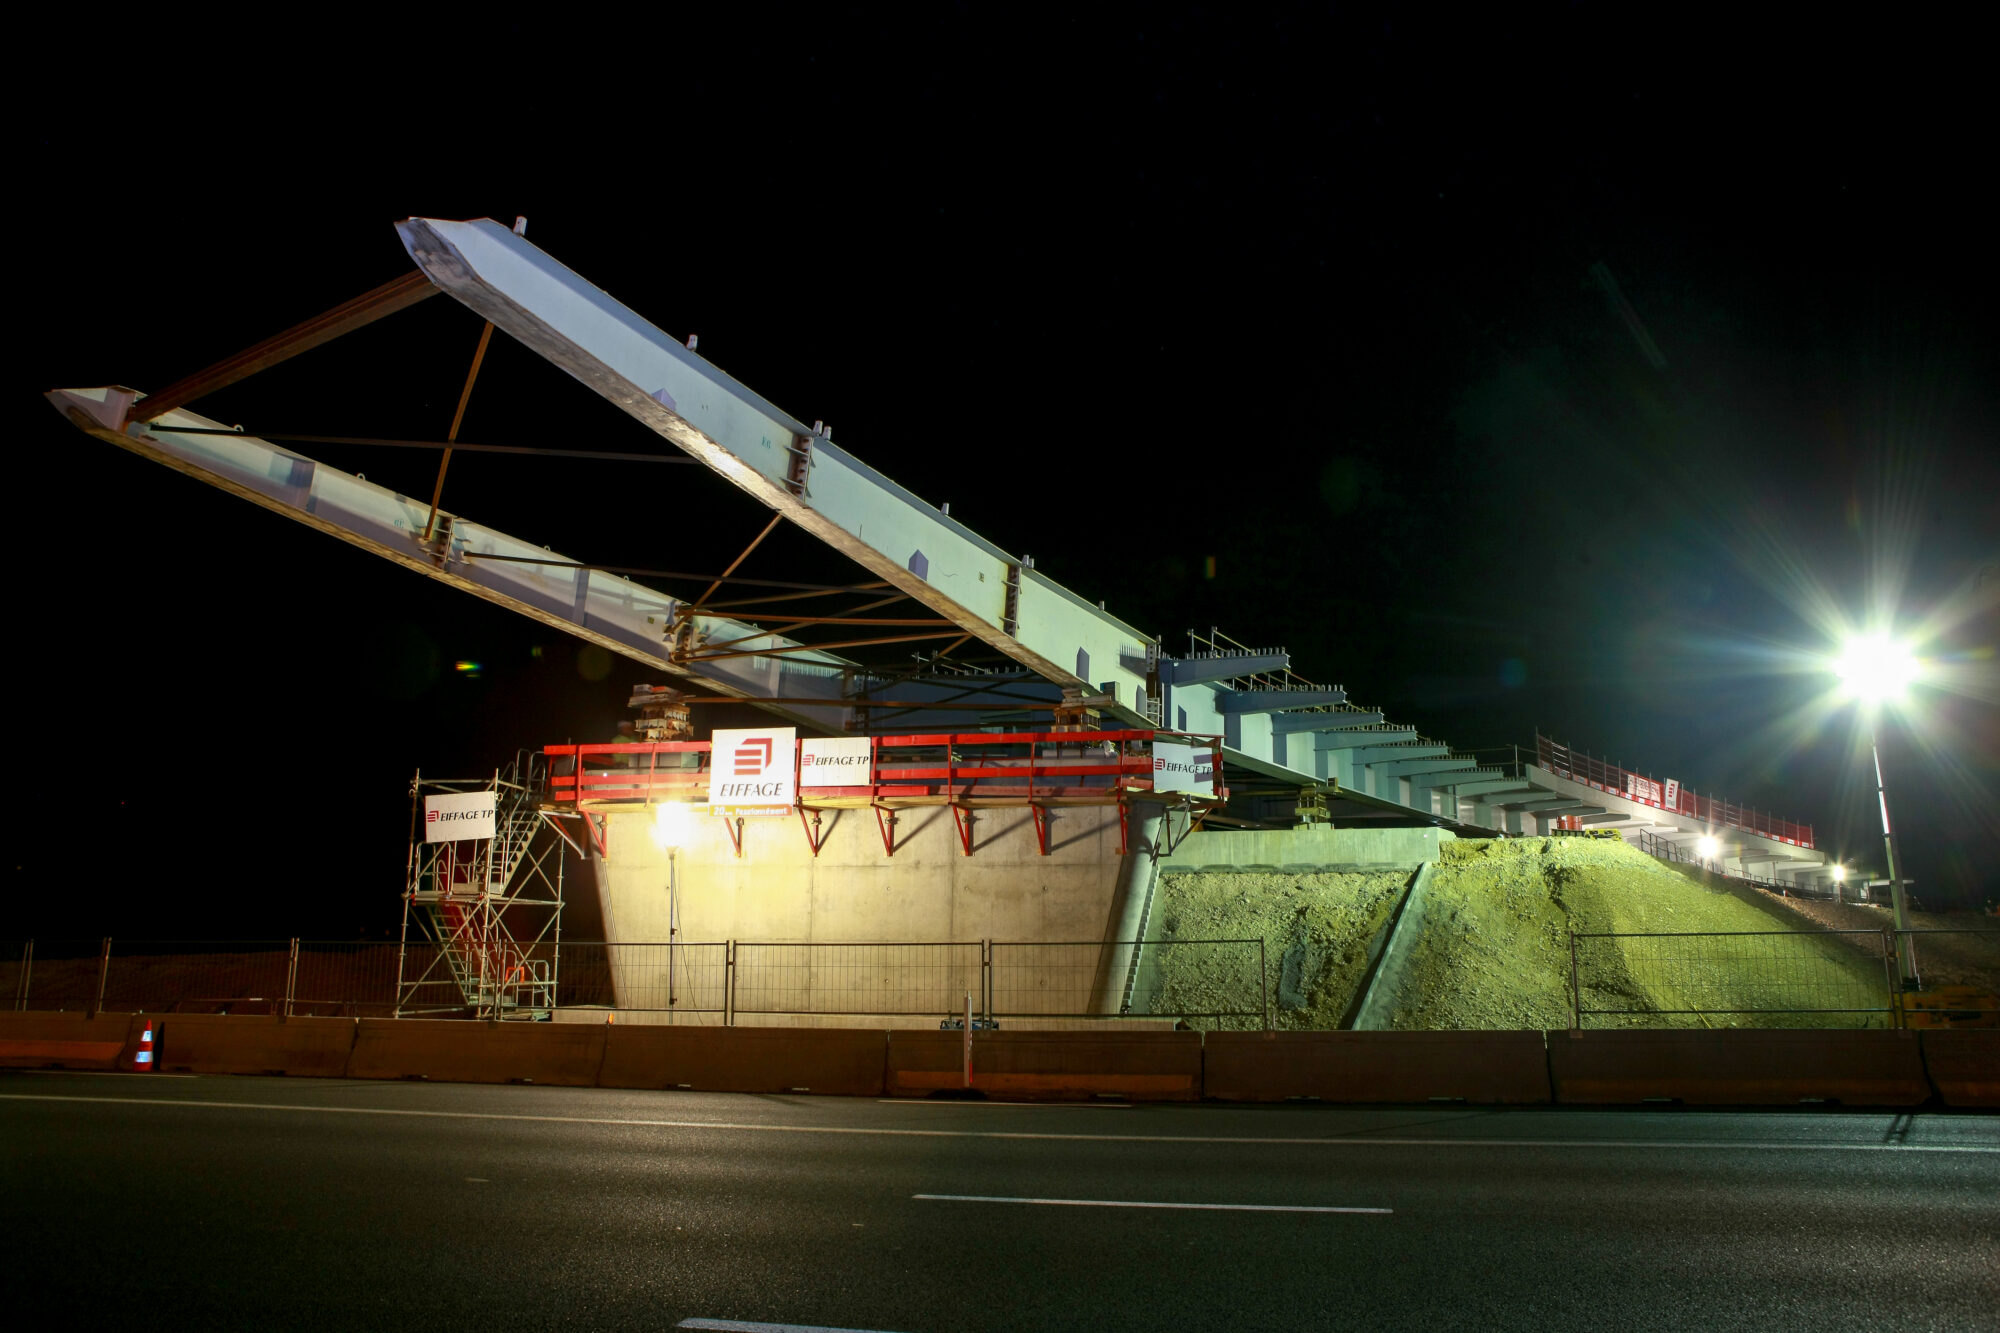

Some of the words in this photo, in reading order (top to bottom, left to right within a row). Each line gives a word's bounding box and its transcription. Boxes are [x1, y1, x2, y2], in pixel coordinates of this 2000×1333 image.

[815, 756, 855, 766] EIFFAGE
[856, 756, 869, 765] TP
[1166, 762, 1200, 774] EIFFAGE
[1202, 766, 1212, 775] TP
[719, 782, 783, 797] EIFFAGE
[440, 811, 479, 821] EIFFAGE
[481, 810, 494, 818] TP
